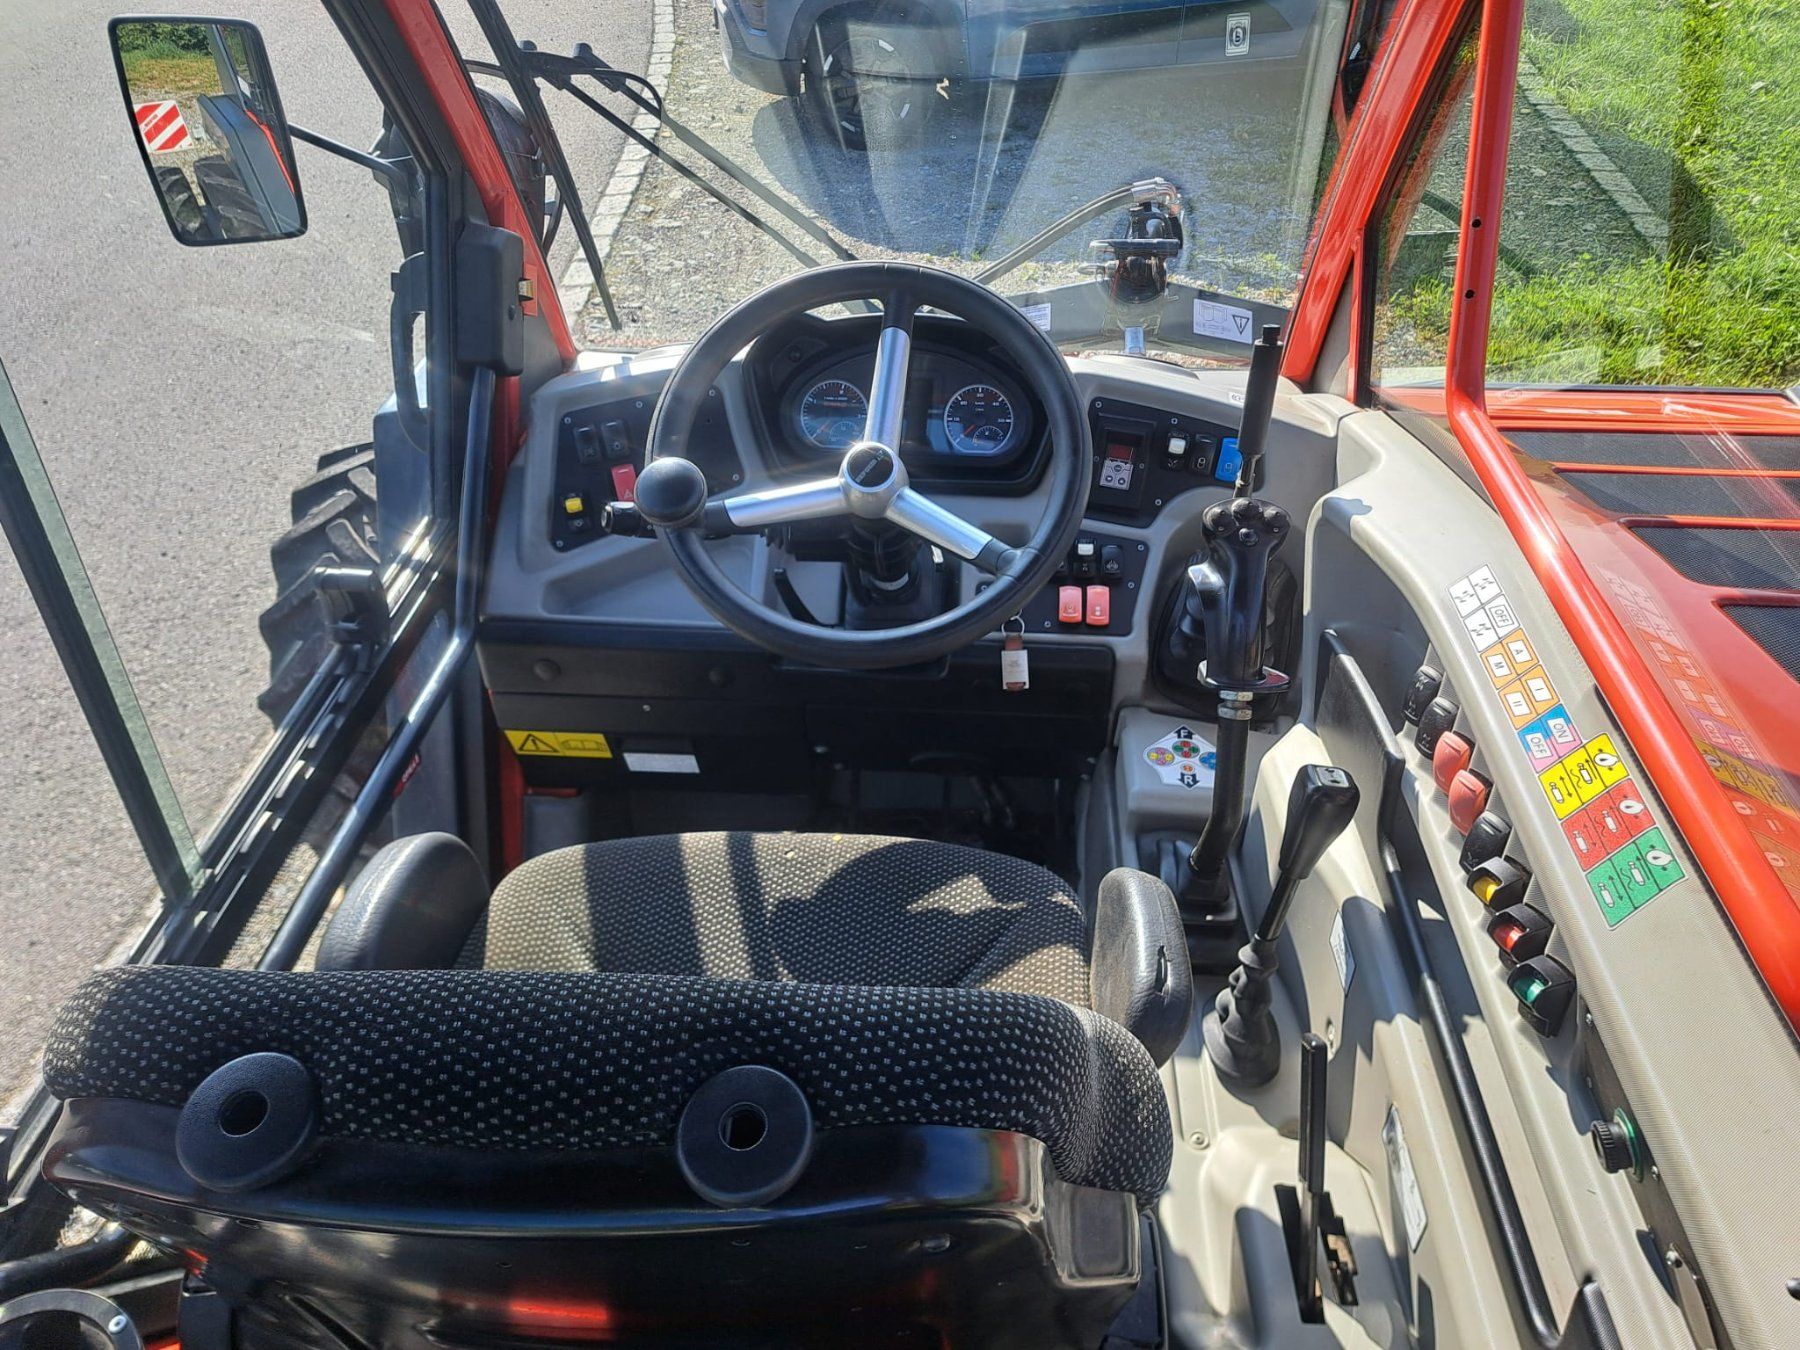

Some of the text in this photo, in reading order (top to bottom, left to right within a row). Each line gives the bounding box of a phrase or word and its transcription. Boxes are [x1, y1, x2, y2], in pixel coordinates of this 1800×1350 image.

[1494, 609, 1510, 624] OFF
[1494, 661, 1505, 670] M
[1181, 730, 1188, 738] F
[1553, 723, 1569, 739] ON
[1530, 736, 1548, 754] OFF
[1184, 775, 1194, 785] R
